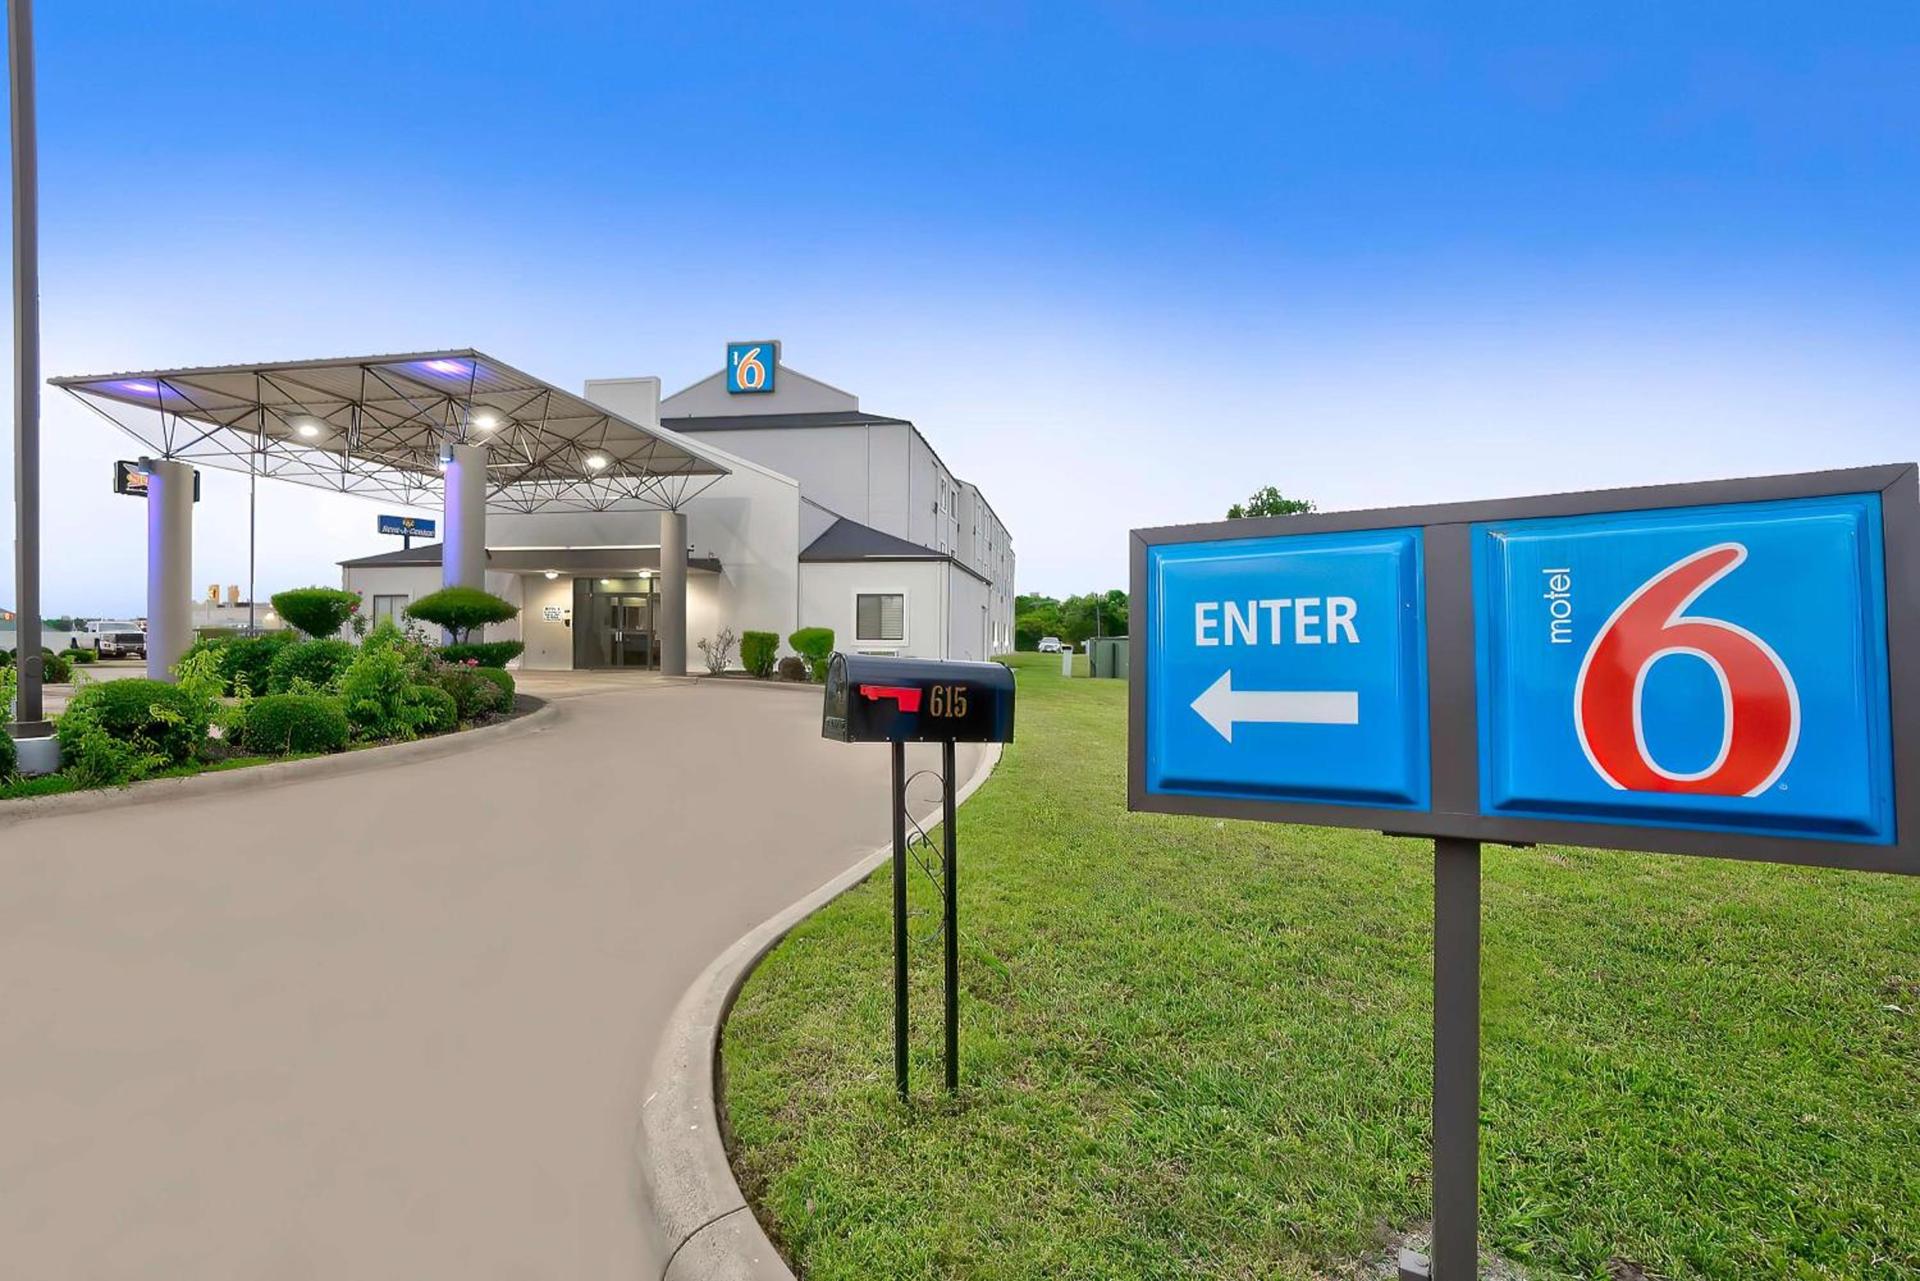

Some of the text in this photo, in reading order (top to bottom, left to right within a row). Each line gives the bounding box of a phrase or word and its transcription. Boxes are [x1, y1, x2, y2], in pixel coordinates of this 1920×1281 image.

[737, 347, 766, 389] 6
[1195, 596, 1361, 646] ENTER
[1542, 567, 1572, 643] motel
[1574, 542, 1801, 798] 6
[929, 684, 968, 718] 615
